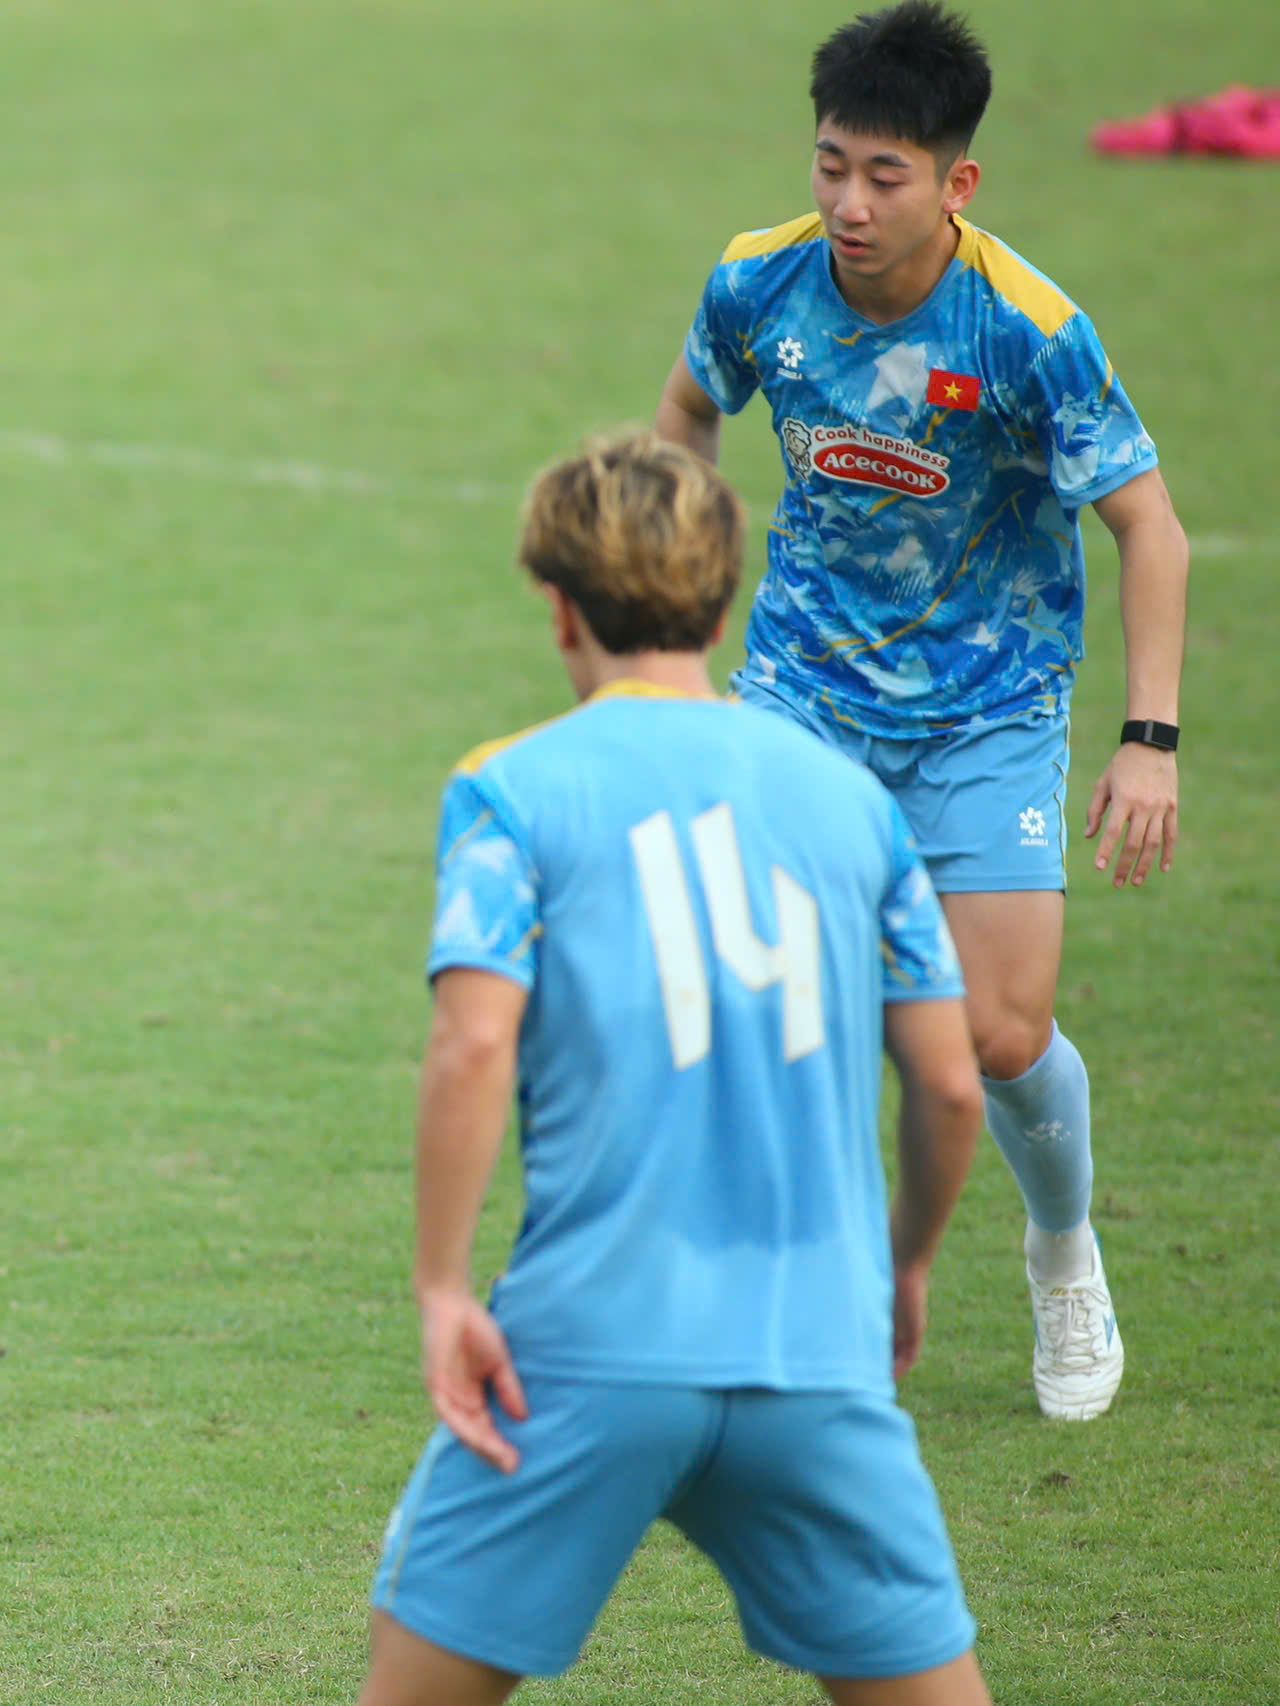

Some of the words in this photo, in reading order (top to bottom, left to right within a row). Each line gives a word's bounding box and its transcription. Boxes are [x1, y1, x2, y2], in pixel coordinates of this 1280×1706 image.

[815, 427, 856, 441] Cook
[863, 429, 947, 467] happiness
[629, 801, 825, 1071] 14
